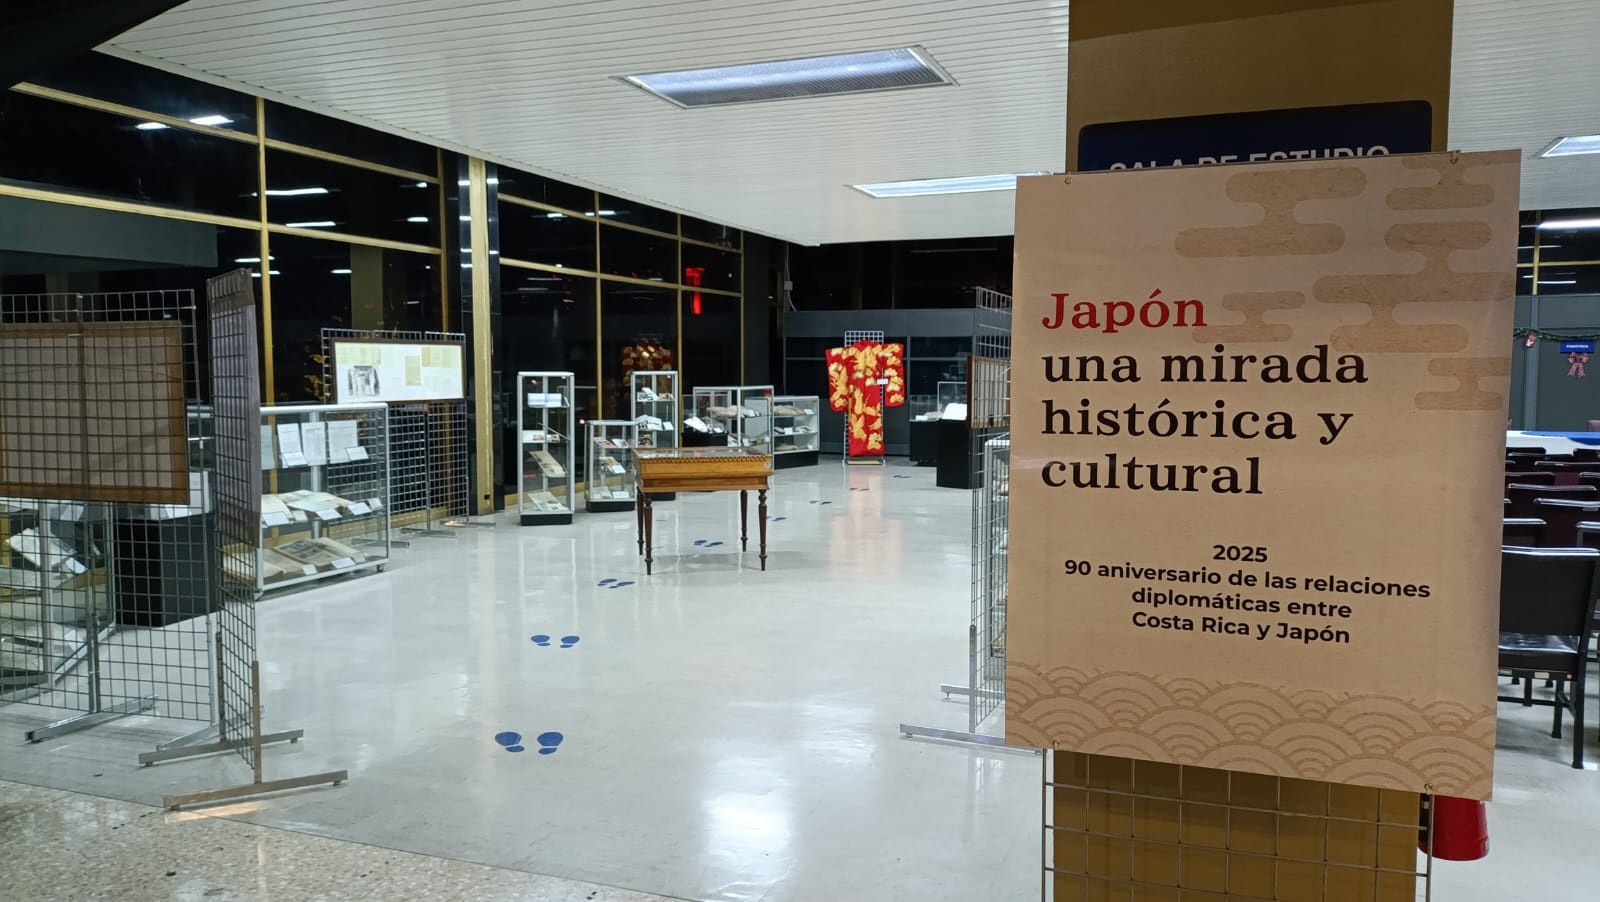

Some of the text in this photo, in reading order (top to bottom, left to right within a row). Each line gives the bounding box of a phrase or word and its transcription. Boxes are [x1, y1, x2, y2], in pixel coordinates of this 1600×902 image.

[1042, 288, 1208, 334] Japón
[1041, 344, 1369, 384] una mirada
[1041, 398, 1354, 446] histórica y
[1041, 453, 1264, 495] cultural
[1212, 544, 1268, 563] 2025
[1064, 559, 1431, 598] 90 aniversario de las relaciones
[1131, 586, 1353, 619] diplomáticas entre
[1132, 611, 1350, 645] Costa Rica y Japón
